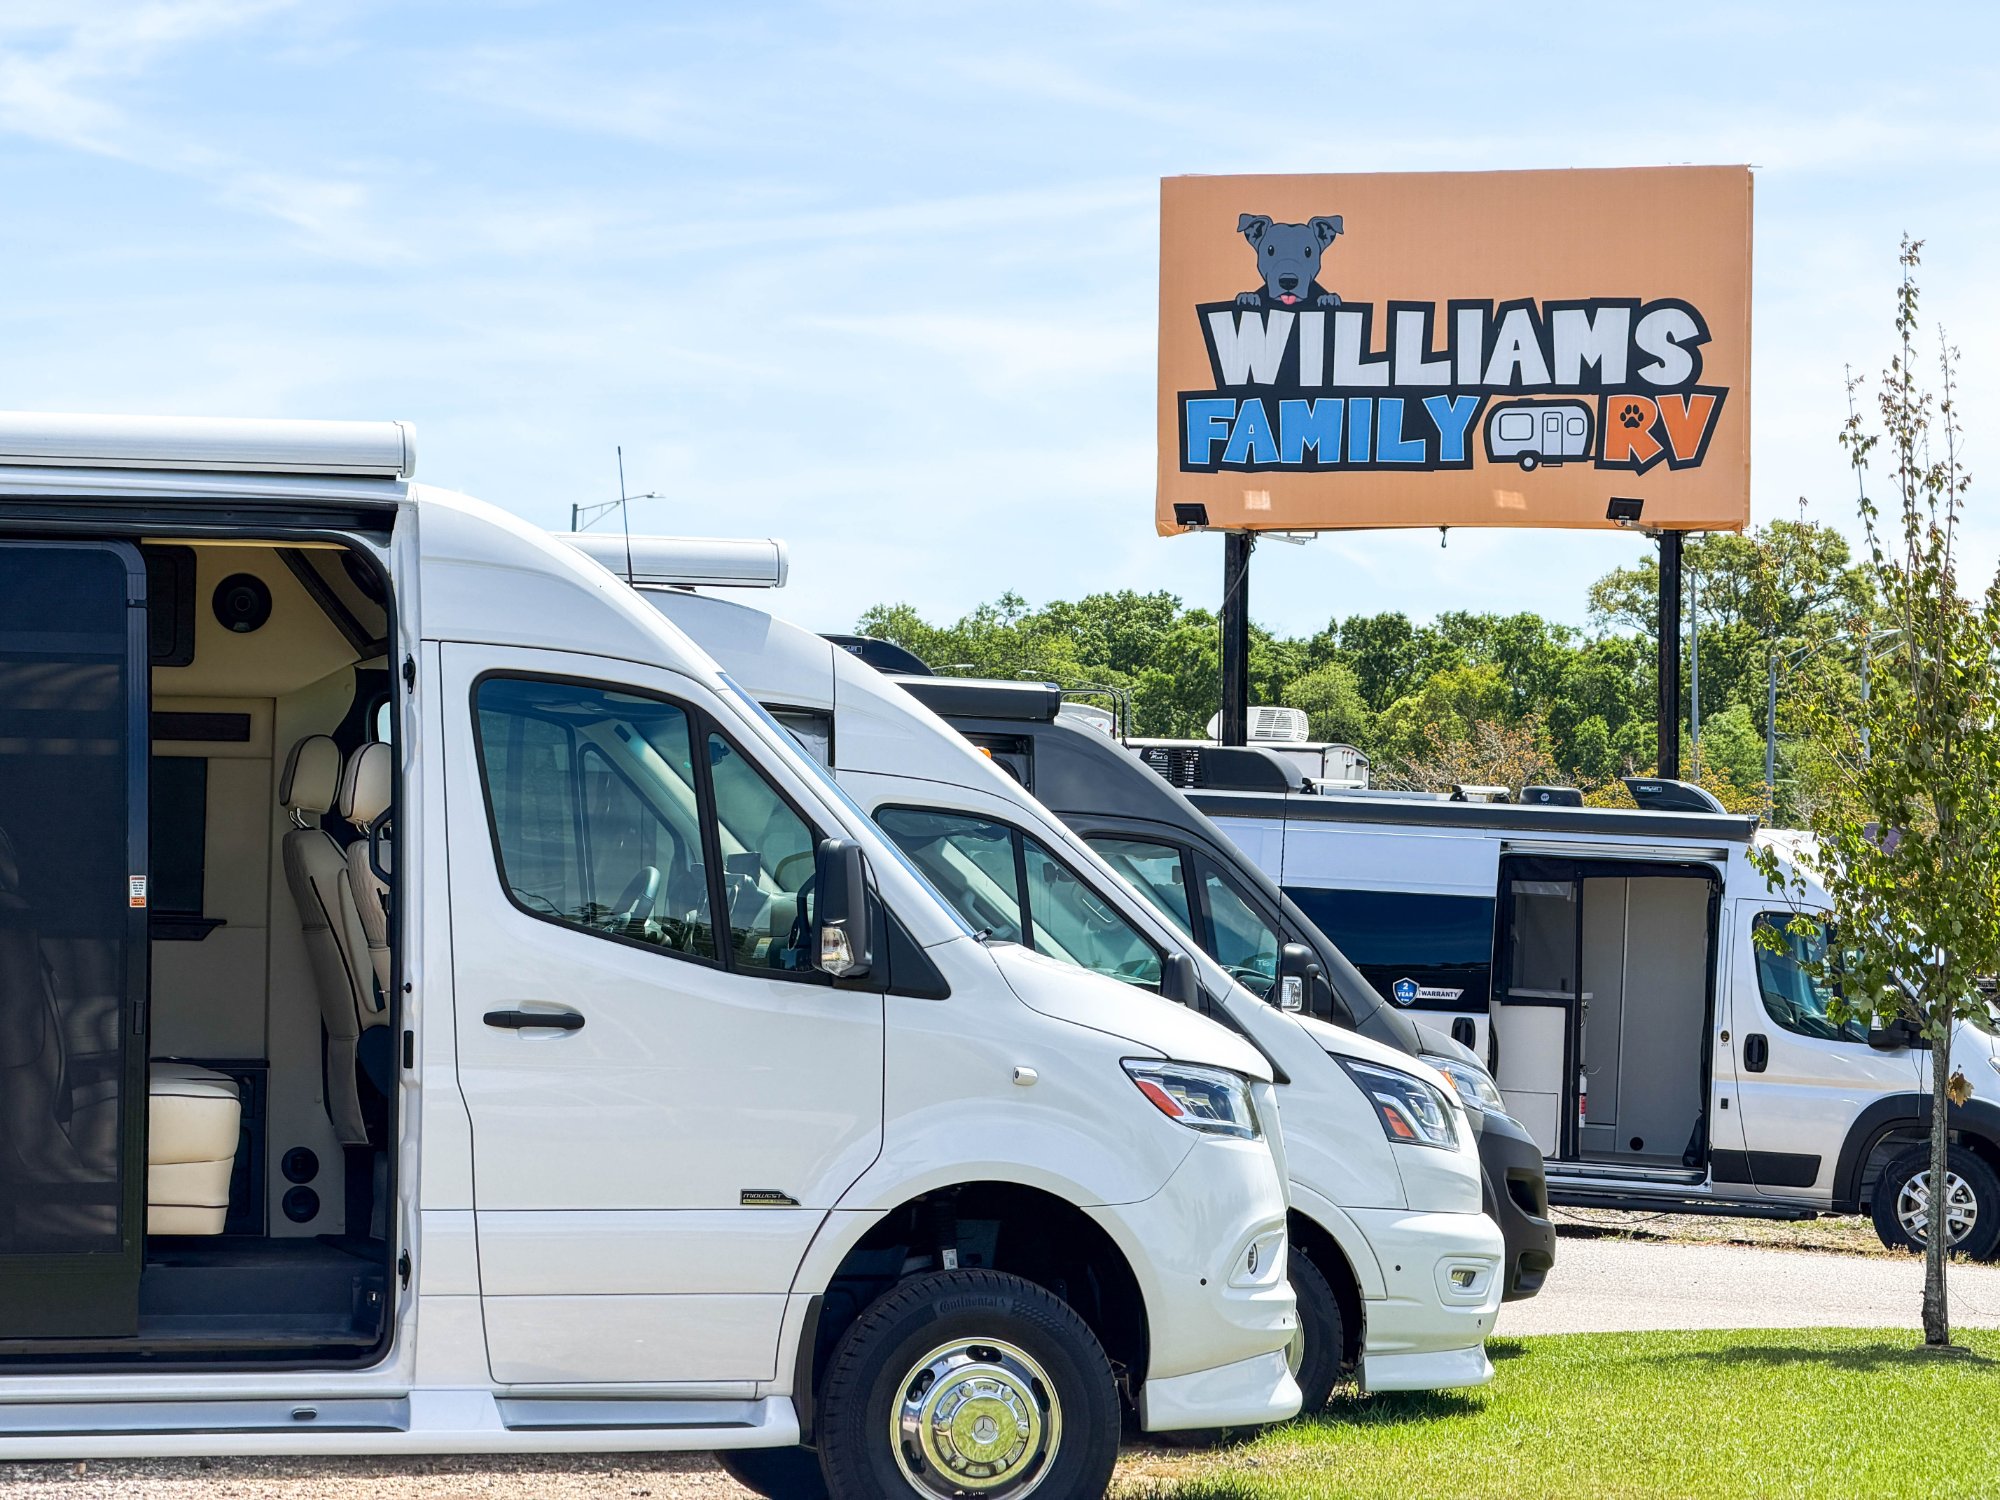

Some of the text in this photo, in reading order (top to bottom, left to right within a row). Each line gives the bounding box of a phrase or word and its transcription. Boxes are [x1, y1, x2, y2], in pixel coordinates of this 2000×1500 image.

[1206, 307, 1700, 387] WILLIAMS
[1186, 394, 1716, 465] FAMILY RV
[1402, 982, 1409, 990] 2
[1421, 990, 1459, 998] WARRANTY
[940, 1296, 998, 1313] Continental
